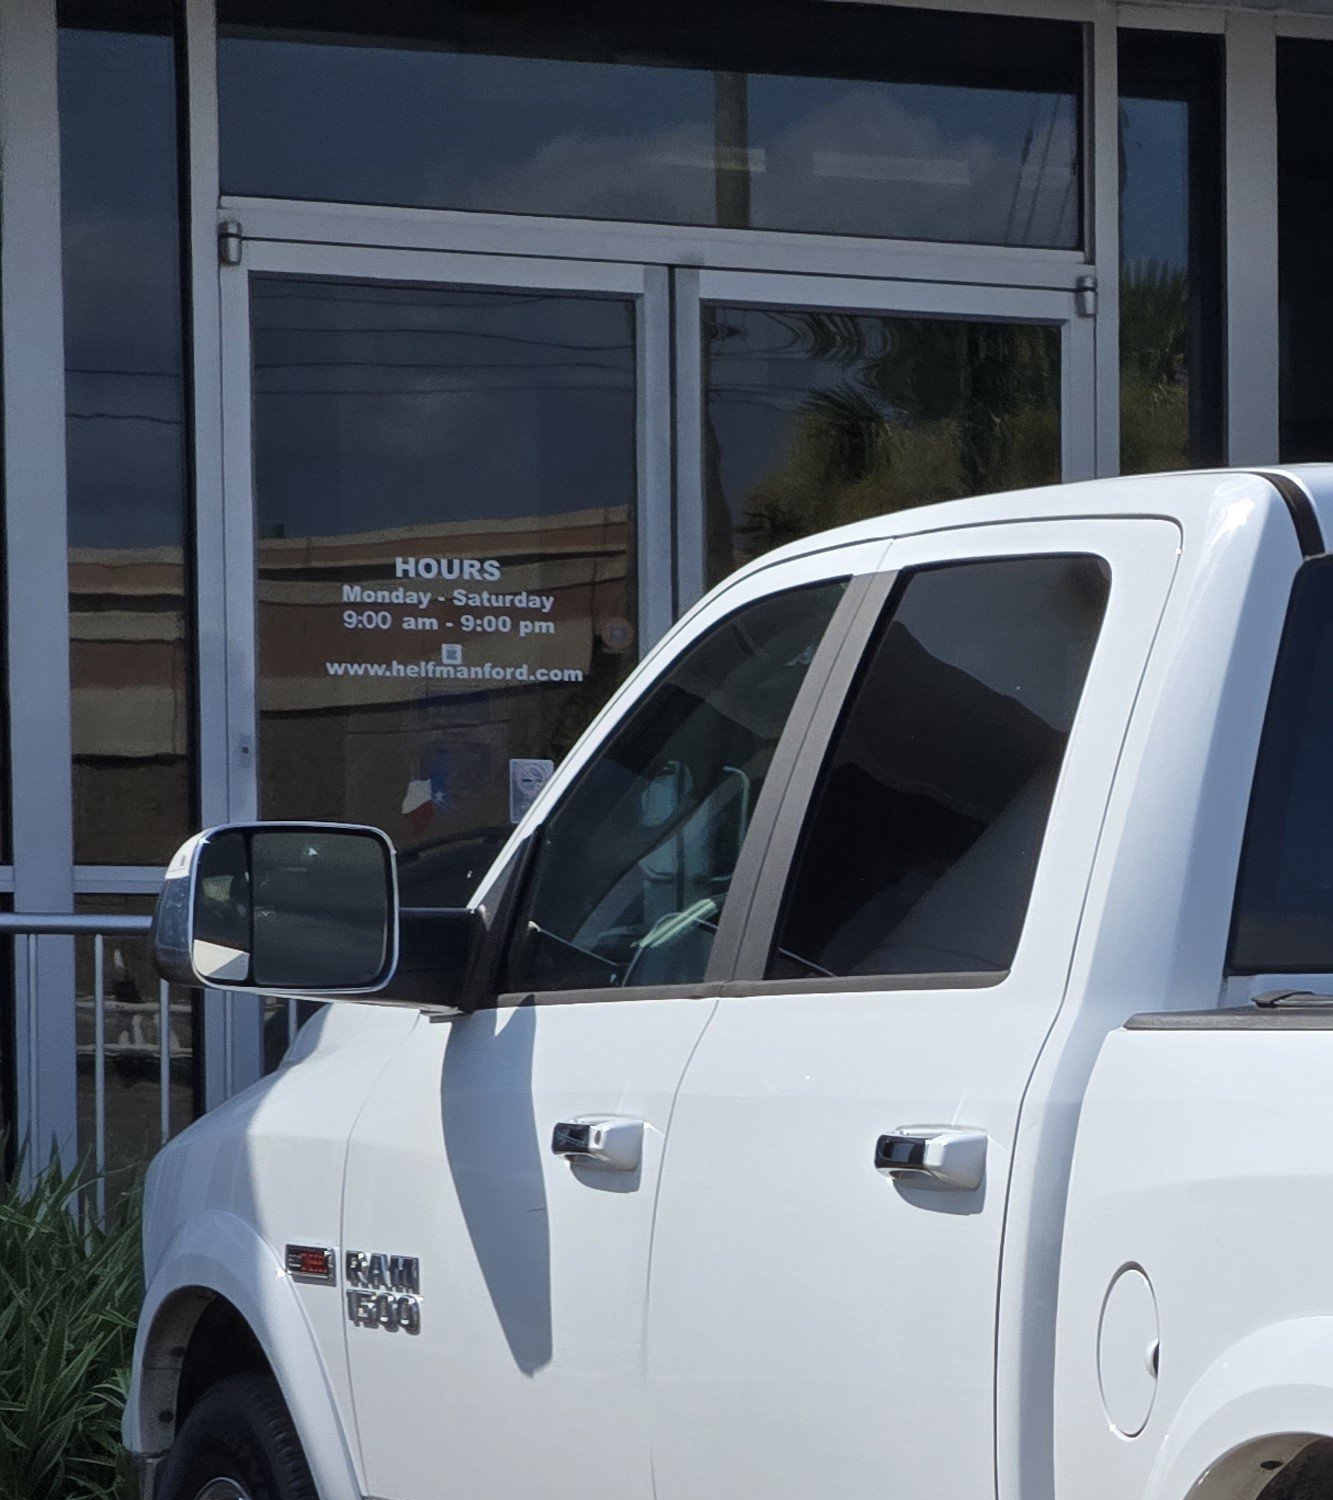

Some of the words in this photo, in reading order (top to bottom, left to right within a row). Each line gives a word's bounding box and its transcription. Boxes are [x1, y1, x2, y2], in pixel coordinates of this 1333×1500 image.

[395, 557, 501, 581] HOURS
[342, 585, 432, 608] Monday
[453, 589, 555, 612] Saturday
[343, 610, 392, 630] 9:00
[402, 617, 439, 630] am
[460, 615, 512, 633] 9:00
[519, 620, 555, 637] pm
[326, 660, 584, 682] www.helfmanford.com
[346, 1250, 421, 1294] RAM
